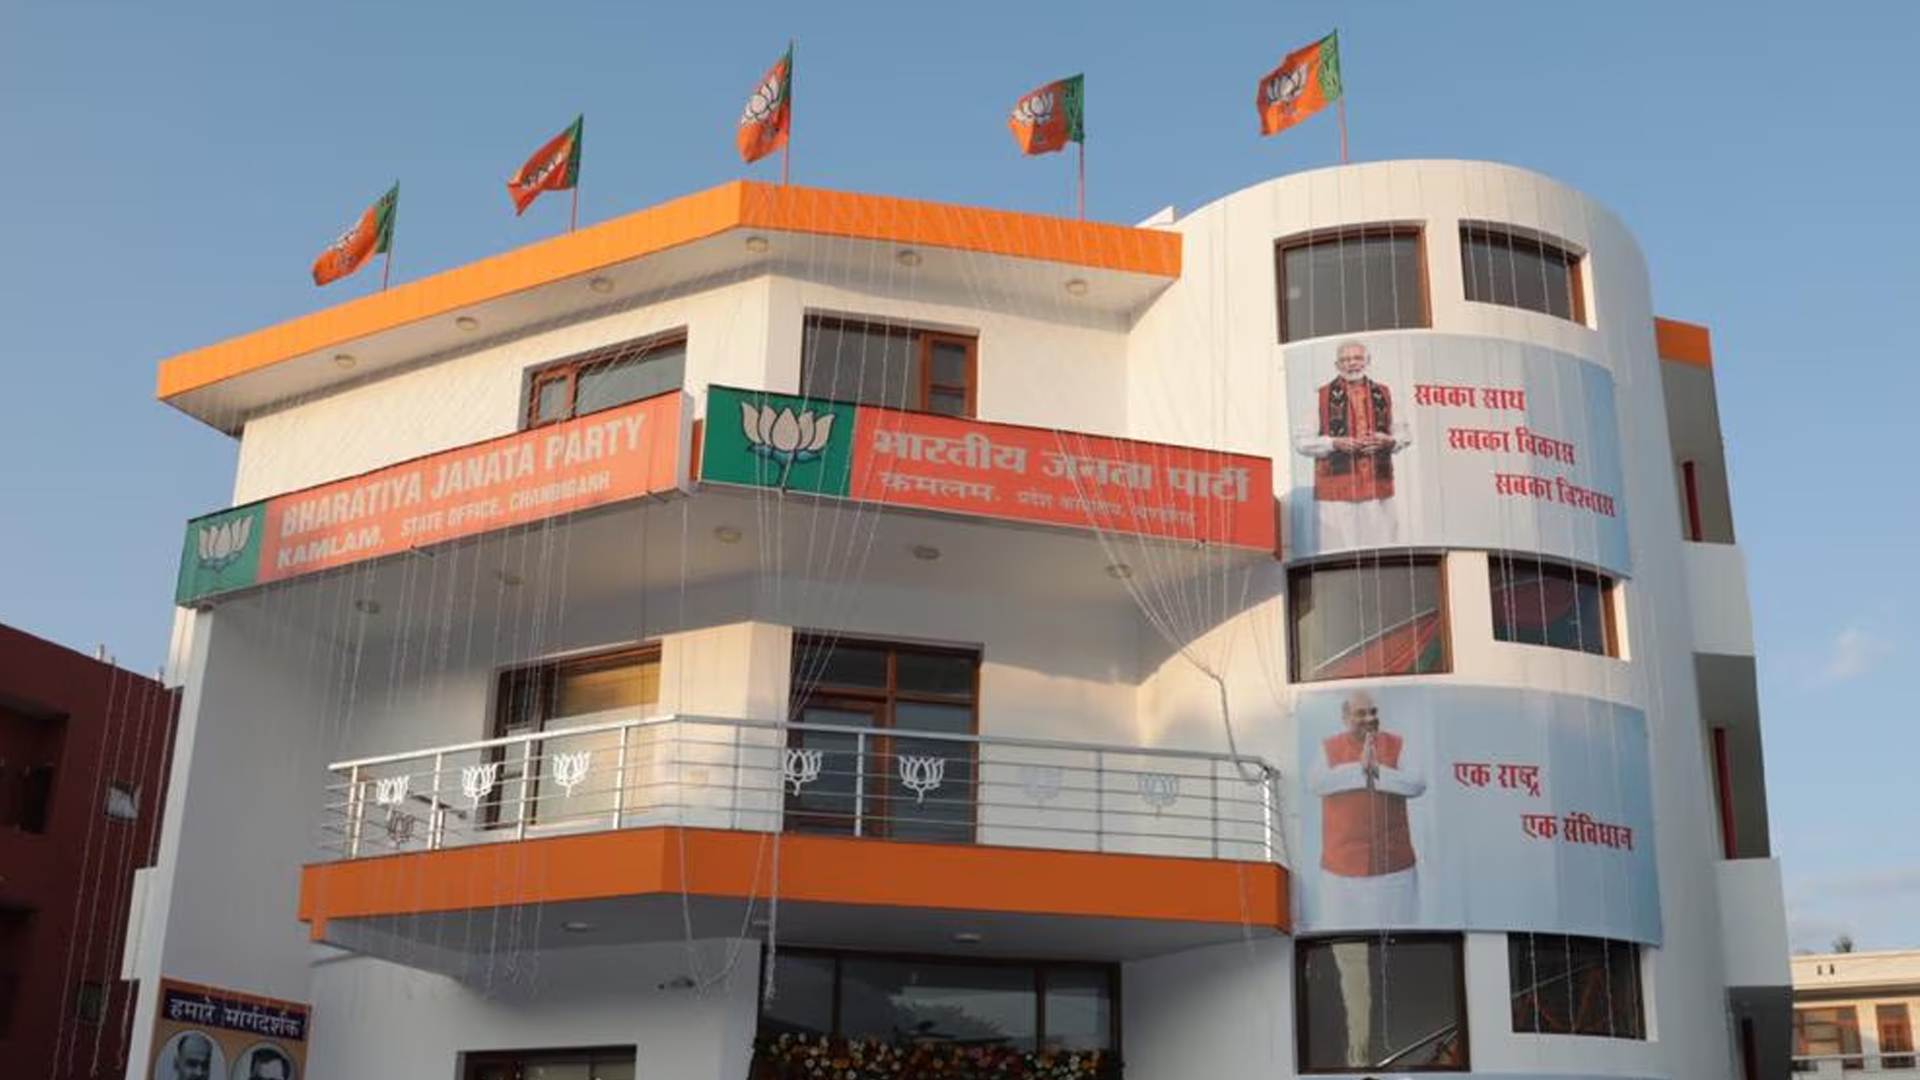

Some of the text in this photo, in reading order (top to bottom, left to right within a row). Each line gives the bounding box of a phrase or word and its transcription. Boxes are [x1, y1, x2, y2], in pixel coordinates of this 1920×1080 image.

[1414, 384, 1526, 411] सबका साथ
[1448, 426, 1576, 465] सबका विकास
[281, 412, 647, 538] BHARATIYA JANATA PARTY
[873, 429, 1250, 503] भारतीय जनता पार्टी
[400, 509, 443, 537] STATE
[509, 469, 612, 511] CHANDIGARH
[1495, 472, 1553, 501] सबका
[1453, 763, 1541, 798] एक राष्ट्र
[1520, 811, 1635, 851] एक संविधान
[169, 996, 300, 1036] हमारे मार्गदर्शक
